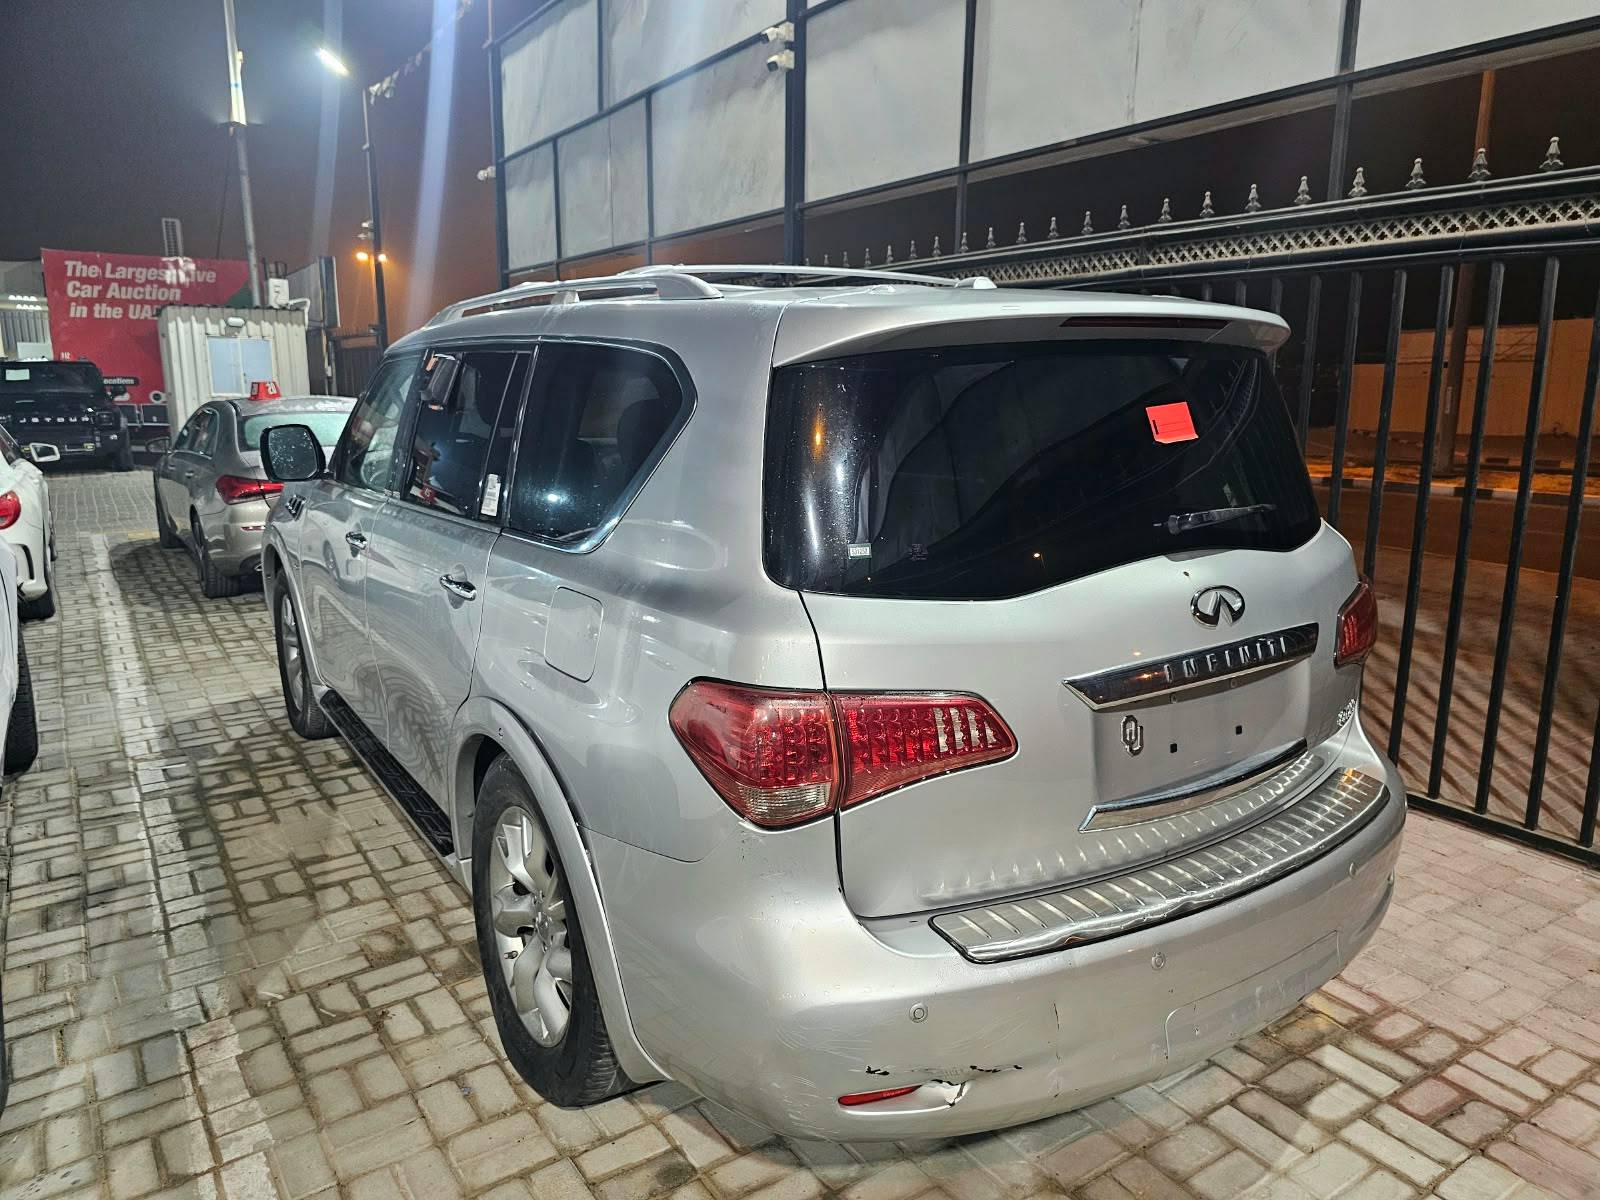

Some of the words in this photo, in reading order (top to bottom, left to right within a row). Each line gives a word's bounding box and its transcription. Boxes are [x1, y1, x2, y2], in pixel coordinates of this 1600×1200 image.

[64, 261, 100, 278] The
[104, 262, 169, 284] Larges
[66, 281, 102, 298] Car
[106, 283, 181, 301] Auction
[69, 302, 88, 318] in
[93, 303, 124, 318] the
[1163, 636, 1287, 684] INFINITI
